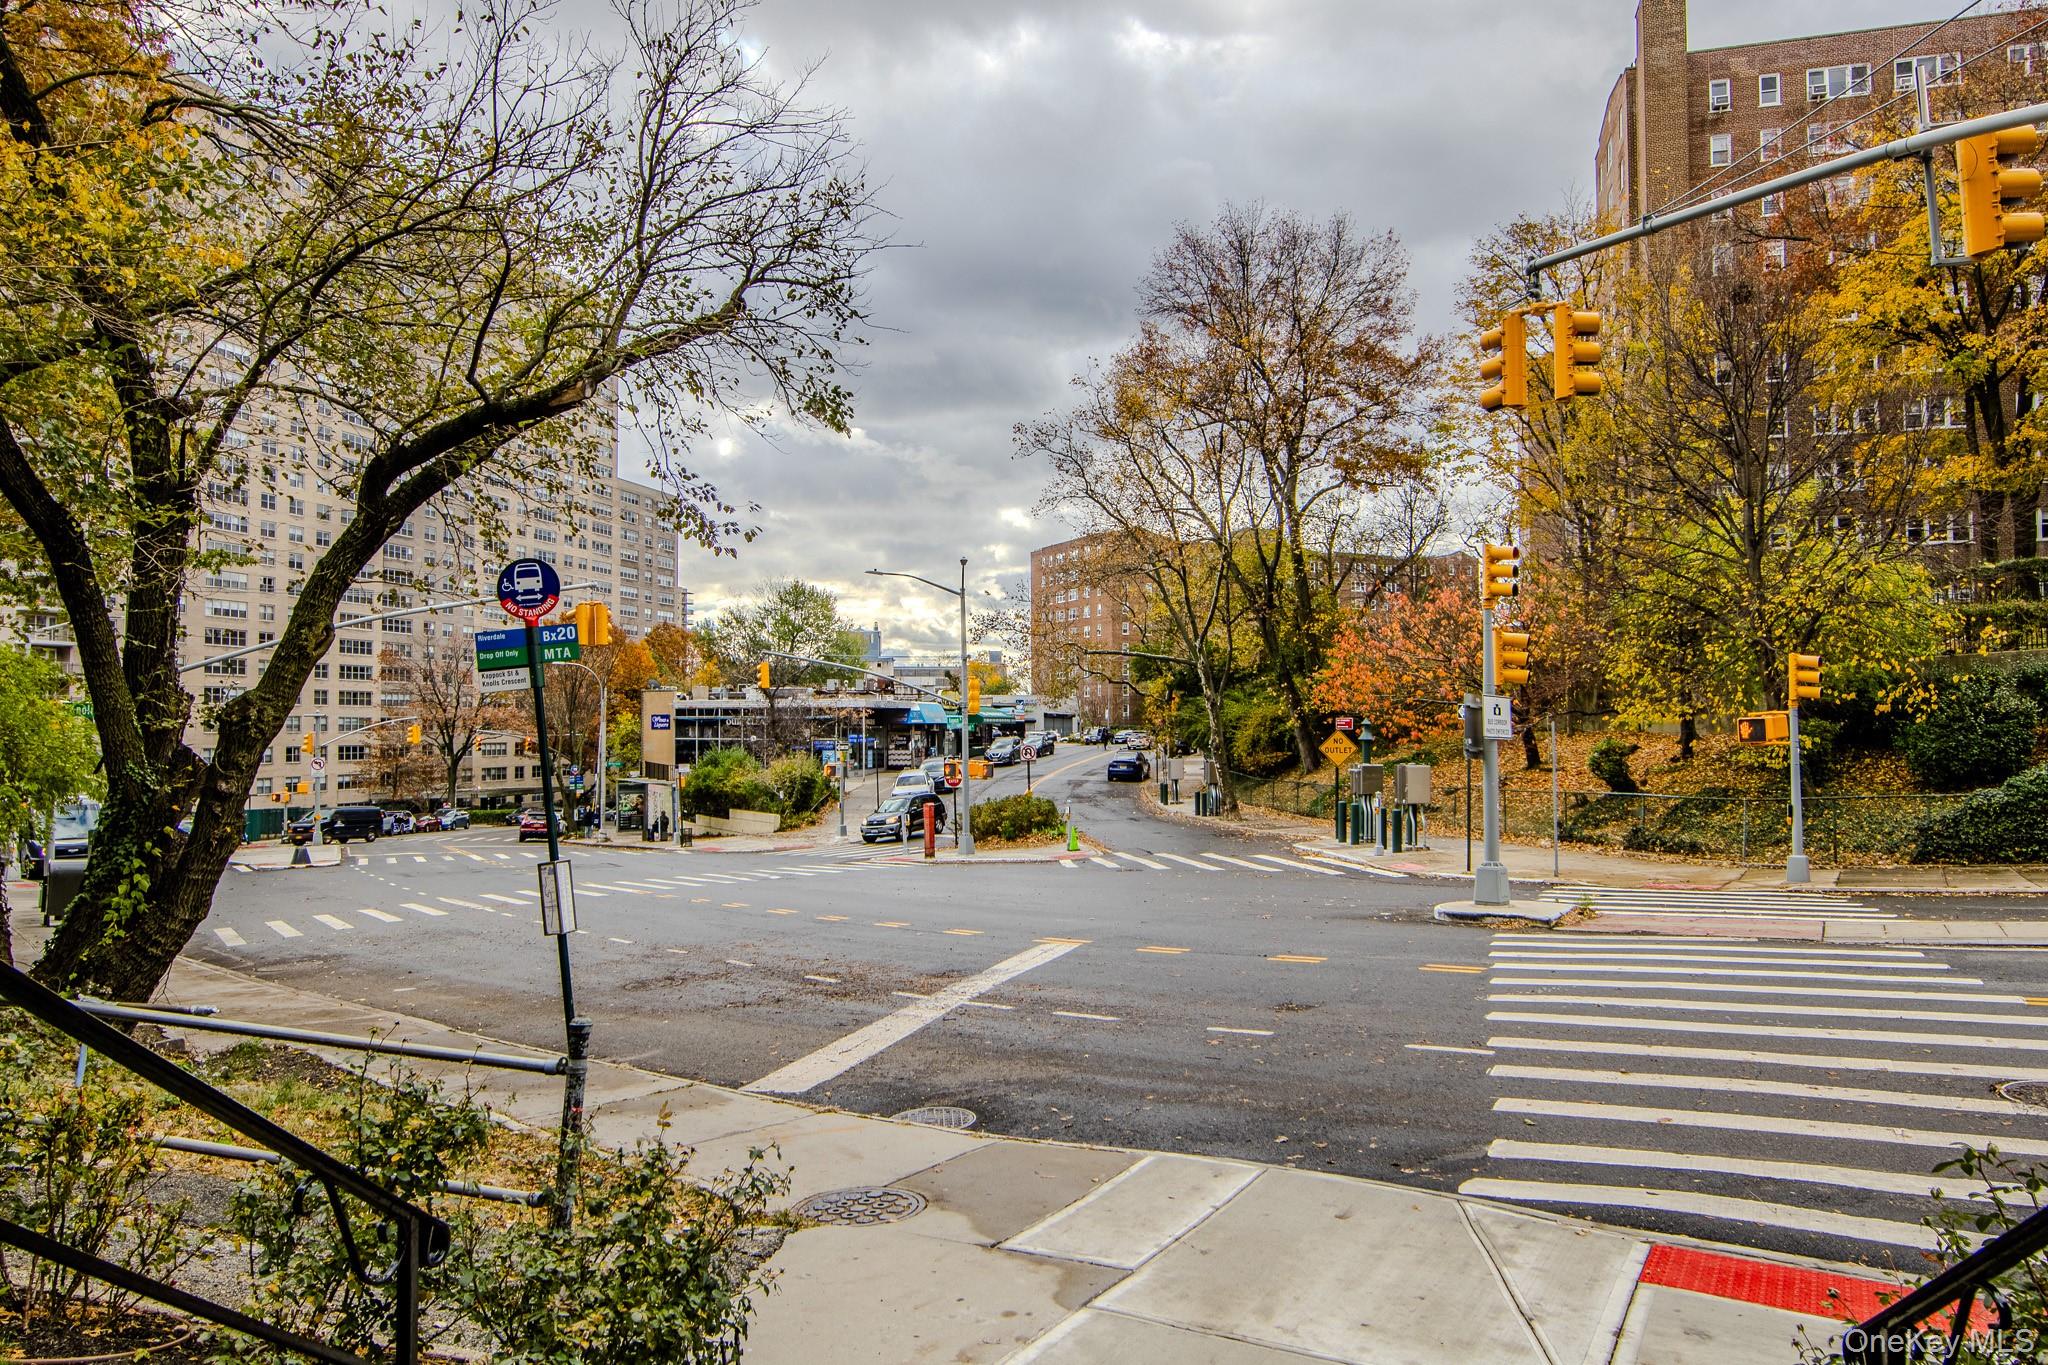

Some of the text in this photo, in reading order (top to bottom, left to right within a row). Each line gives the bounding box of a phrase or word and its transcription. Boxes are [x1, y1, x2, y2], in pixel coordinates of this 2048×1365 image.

[505, 598, 555, 616] NO STANDING
[478, 632, 506, 641] Riverdale
[542, 626, 576, 642] Bx20
[544, 647, 571, 660] MTA
[482, 679, 499, 687] Knolls
